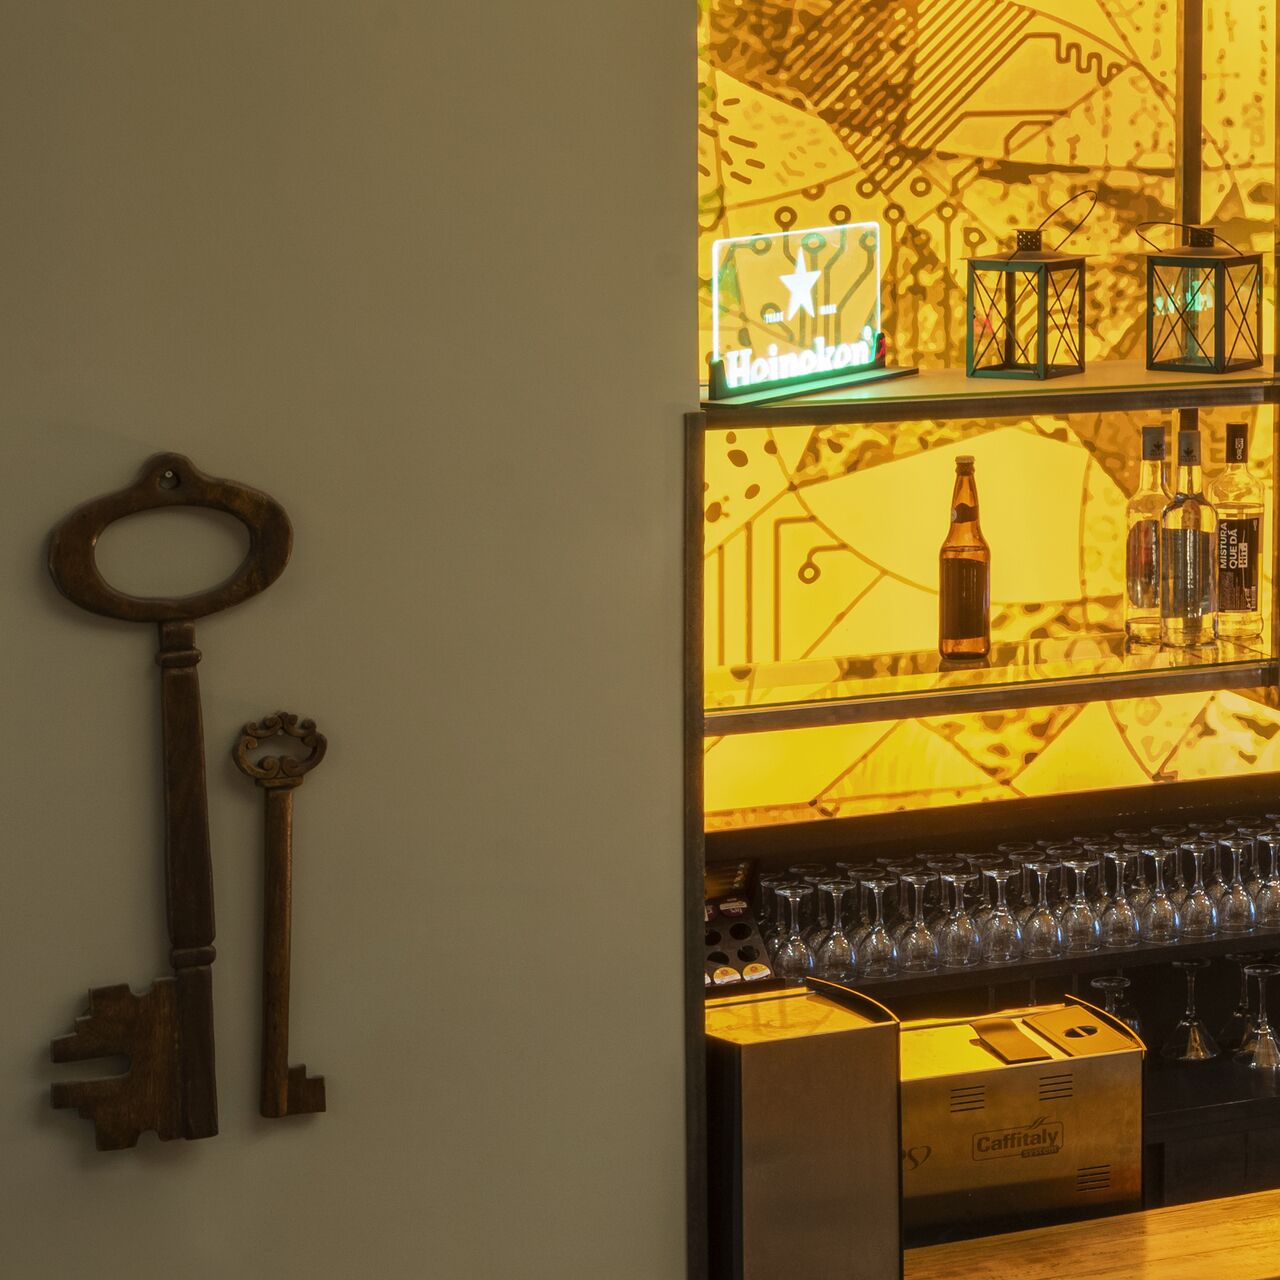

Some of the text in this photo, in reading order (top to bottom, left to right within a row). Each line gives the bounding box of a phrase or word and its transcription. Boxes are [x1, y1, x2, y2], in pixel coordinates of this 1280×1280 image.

[1220, 522, 1228, 569] MISTURA
[1228, 528, 1238, 569] QUE DÁ
[977, 1129, 1059, 1153] Caffitaly
